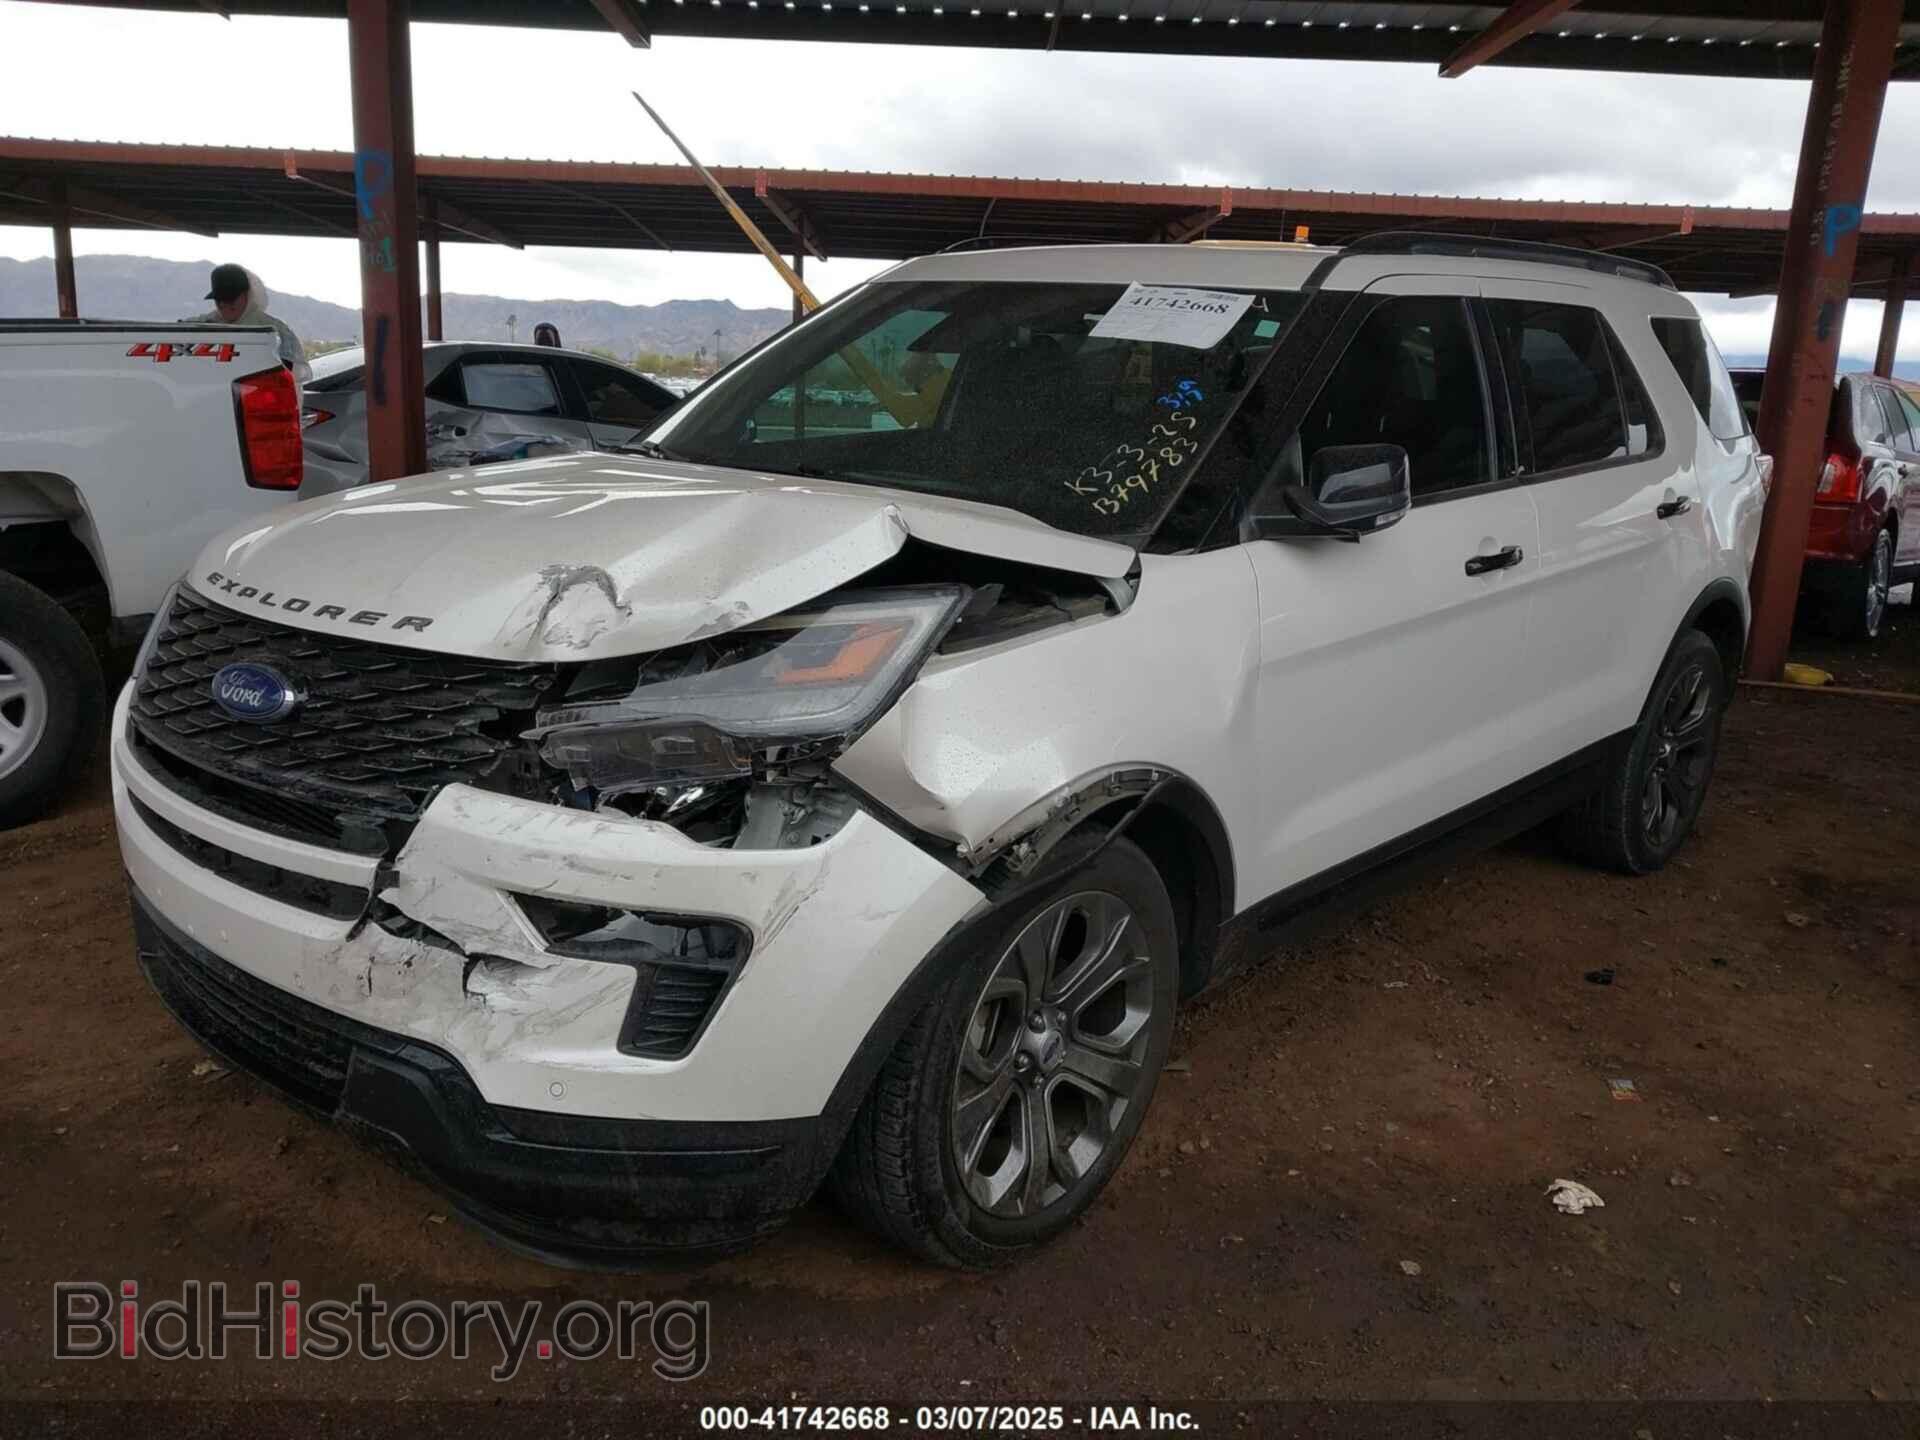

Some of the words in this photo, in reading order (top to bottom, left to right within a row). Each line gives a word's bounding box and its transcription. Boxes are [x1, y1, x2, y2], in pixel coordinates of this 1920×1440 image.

[1825, 204, 1865, 257] P
[1129, 296, 1230, 315] 41742668
[206, 571, 434, 632] EXPLORER
[220, 670, 267, 707] Ford
